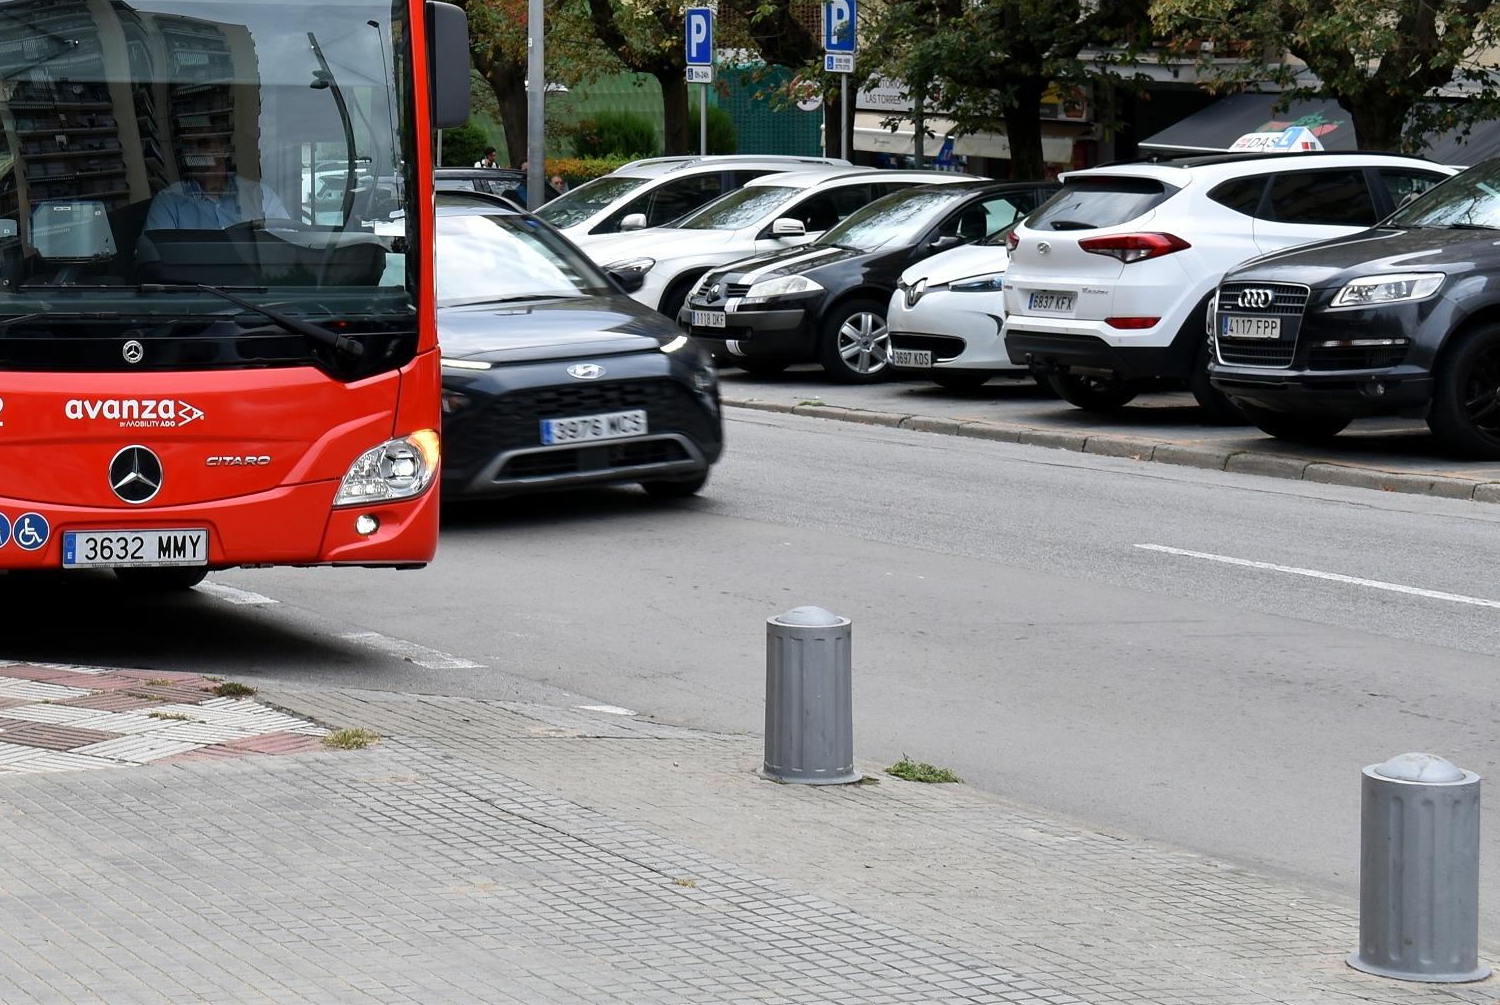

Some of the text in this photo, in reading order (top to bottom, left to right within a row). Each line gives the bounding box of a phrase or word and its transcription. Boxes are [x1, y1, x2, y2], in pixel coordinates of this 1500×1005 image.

[831, 0, 850, 45] P
[690, 14, 707, 58] P
[865, 94, 877, 104] LAS
[1033, 293, 1073, 310] 6837 KFX
[1228, 319, 1278, 334] 4117 FPP
[65, 399, 176, 419] avanza
[206, 455, 271, 466] CITARO
[85, 536, 145, 560] 3632
[158, 534, 201, 559] MMY
